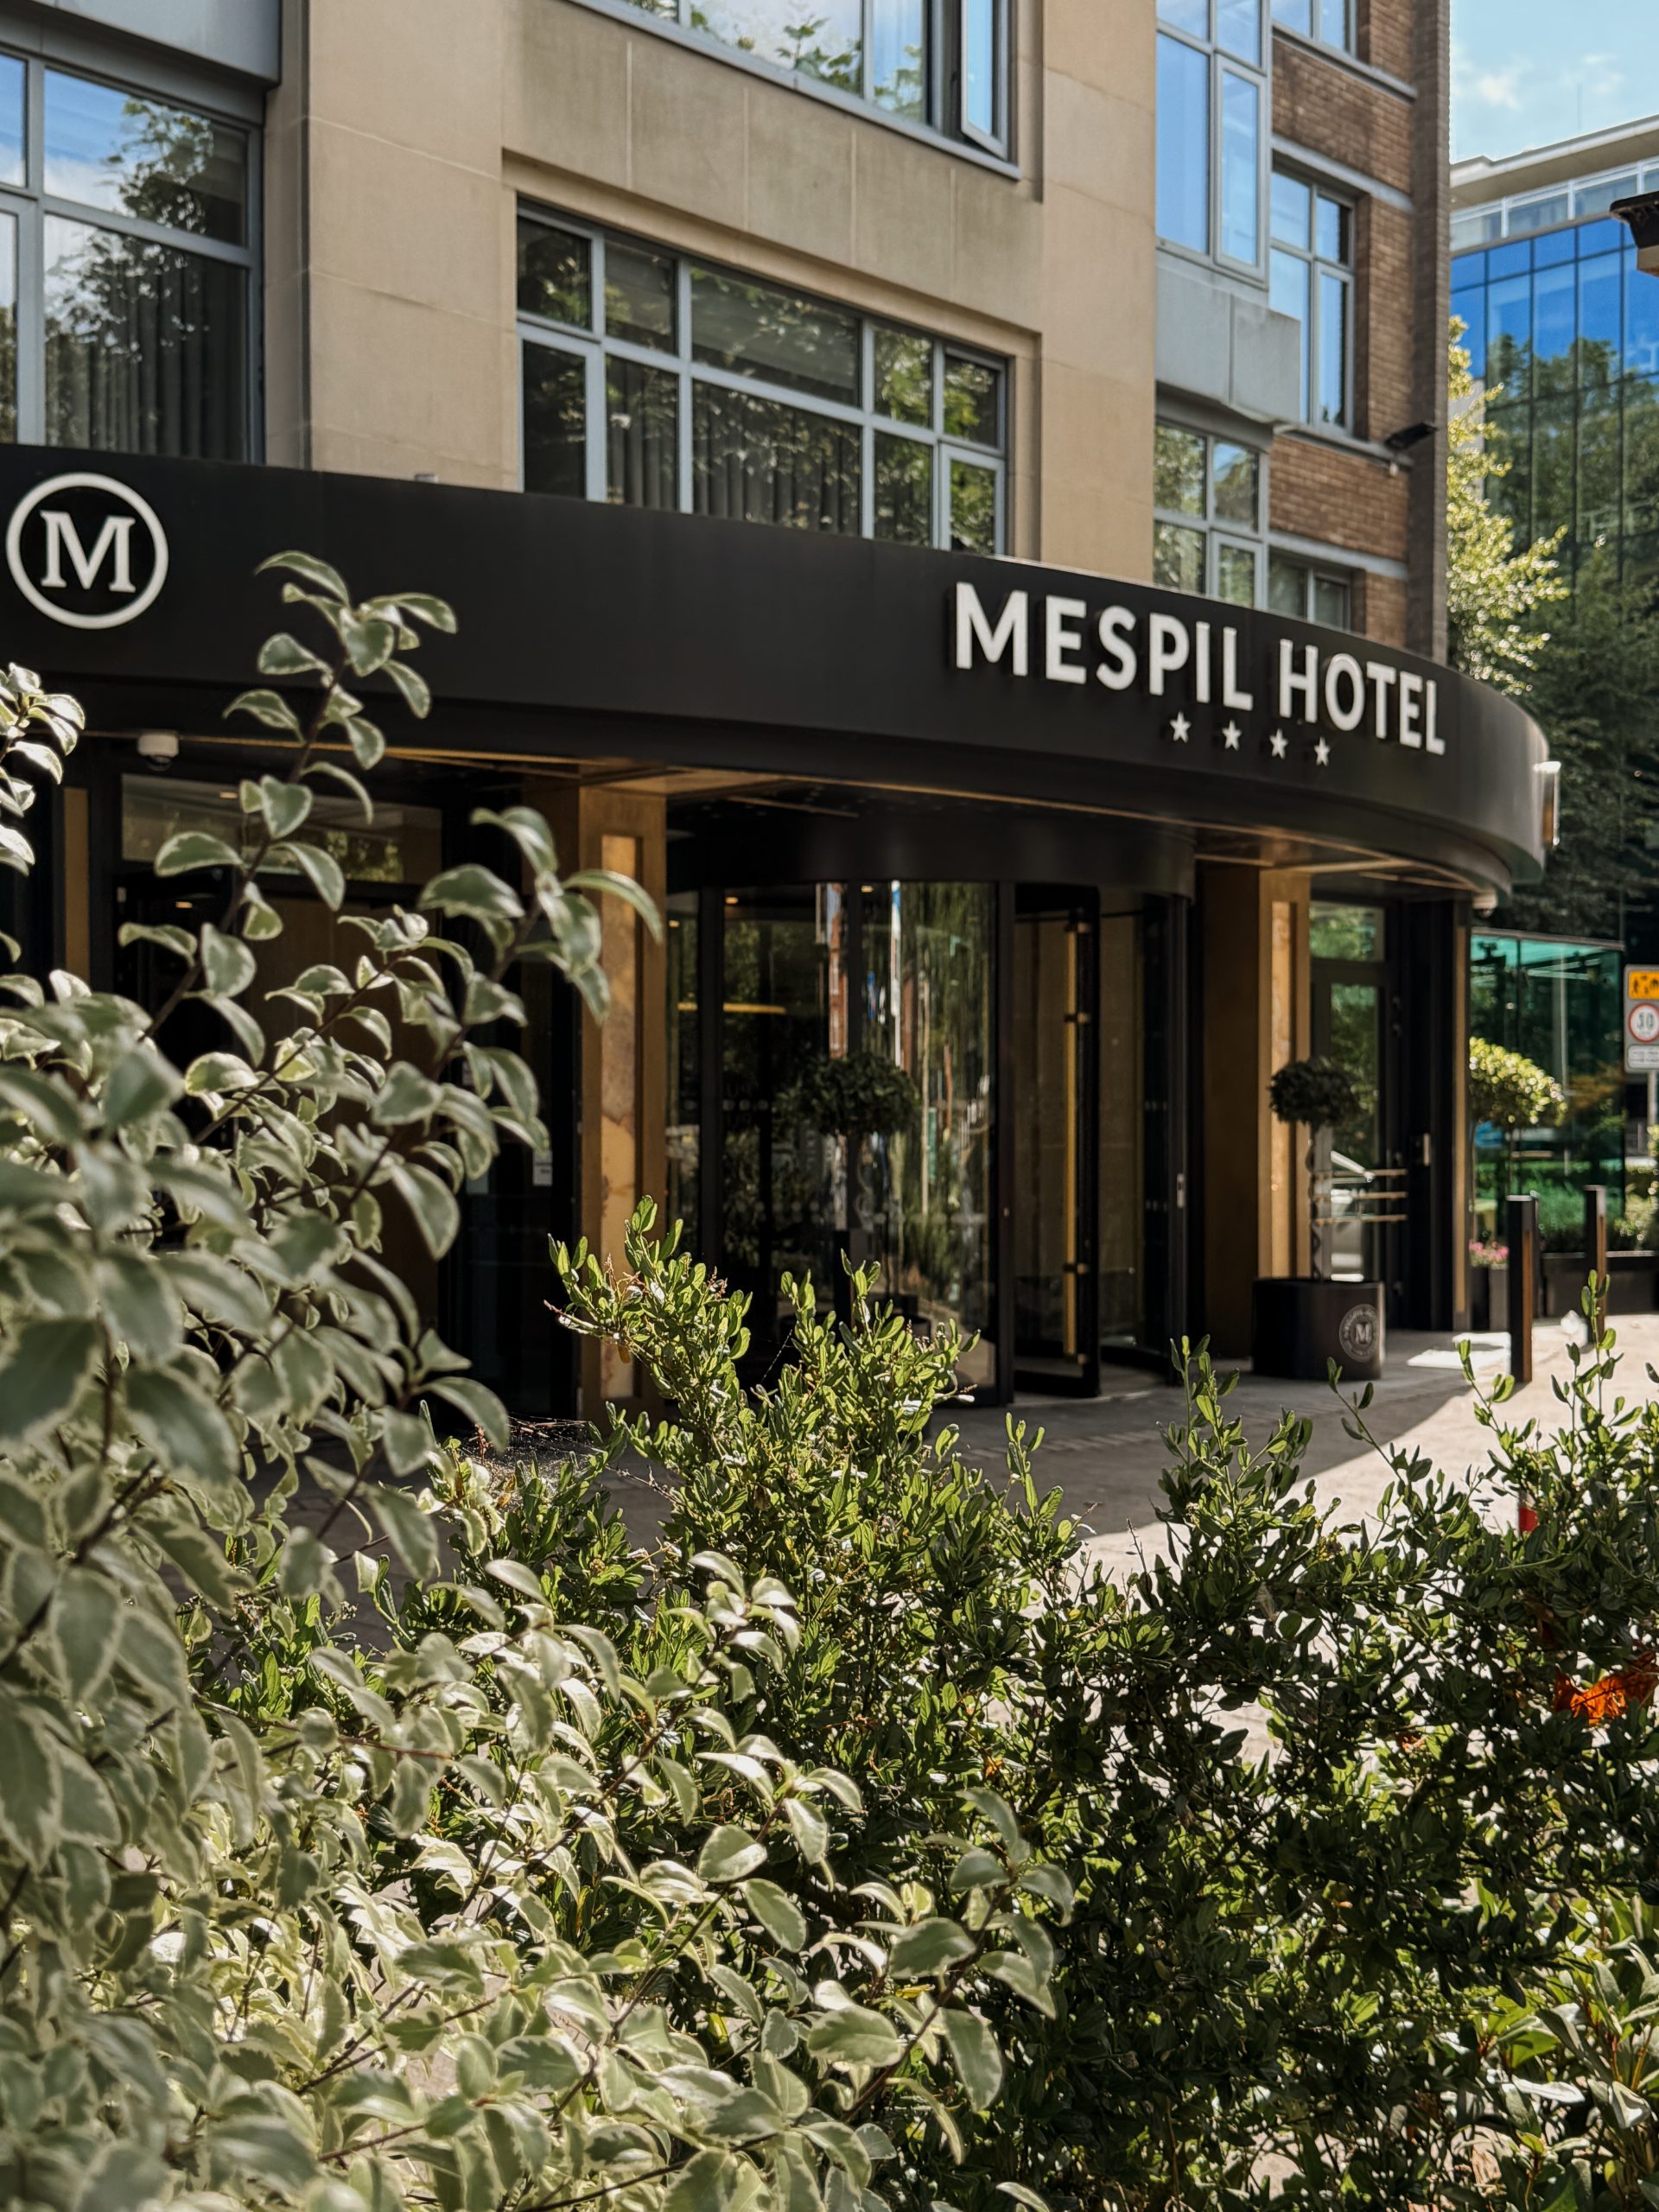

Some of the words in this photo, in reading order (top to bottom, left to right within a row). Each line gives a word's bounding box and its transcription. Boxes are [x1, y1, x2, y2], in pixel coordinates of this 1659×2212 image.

[40, 510, 136, 593] M
[956, 582, 1253, 711] MESPIL
[1279, 639, 1446, 755] HOTEL
[1355, 1322, 1372, 1343] M
